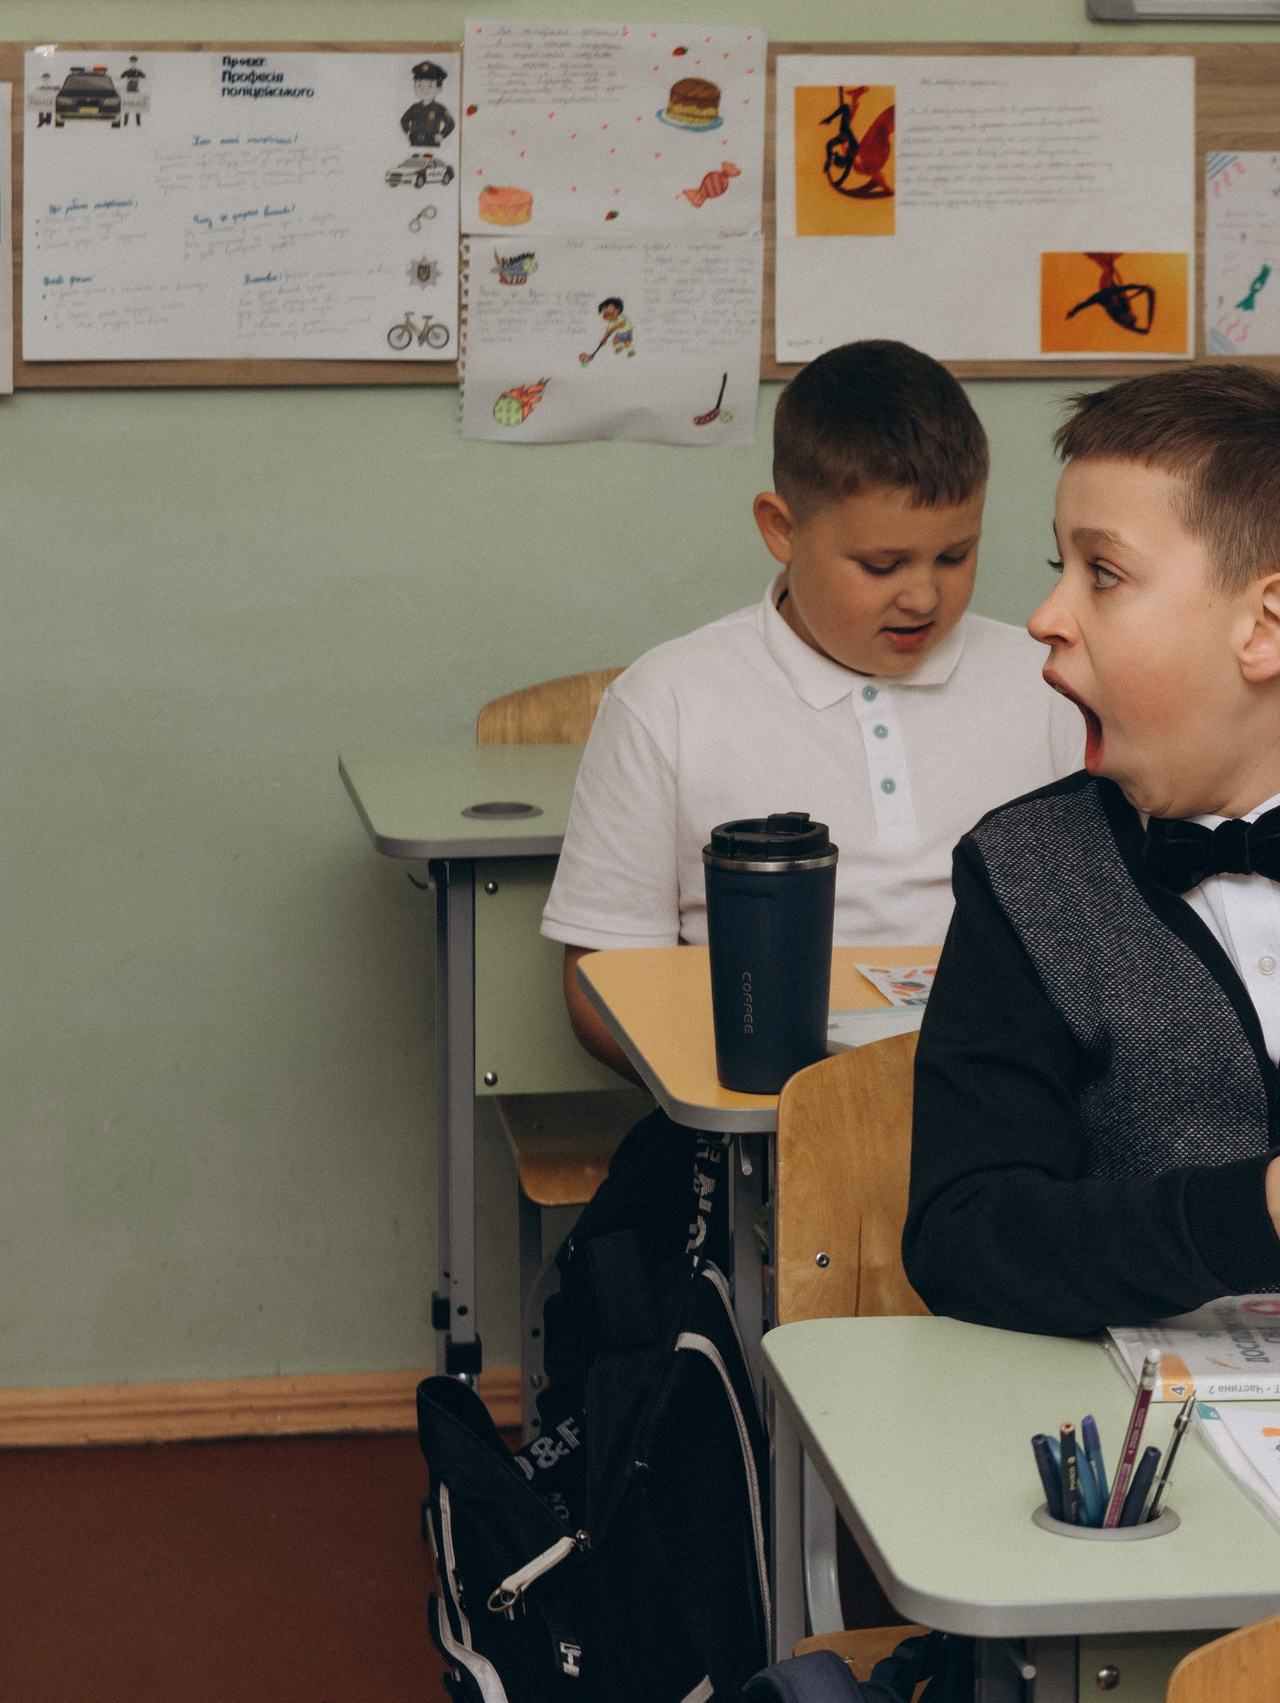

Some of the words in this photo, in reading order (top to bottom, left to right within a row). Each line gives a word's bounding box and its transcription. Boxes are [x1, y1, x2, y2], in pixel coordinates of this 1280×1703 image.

[222, 70, 284, 85] Професія
[222, 85, 315, 99] поліцейського
[741, 971, 755, 1035] COFFEE
[1171, 1386, 1186, 1396] 4
[1208, 1384, 1216, 1395] 2
[1218, 1384, 1264, 1395] Частина
